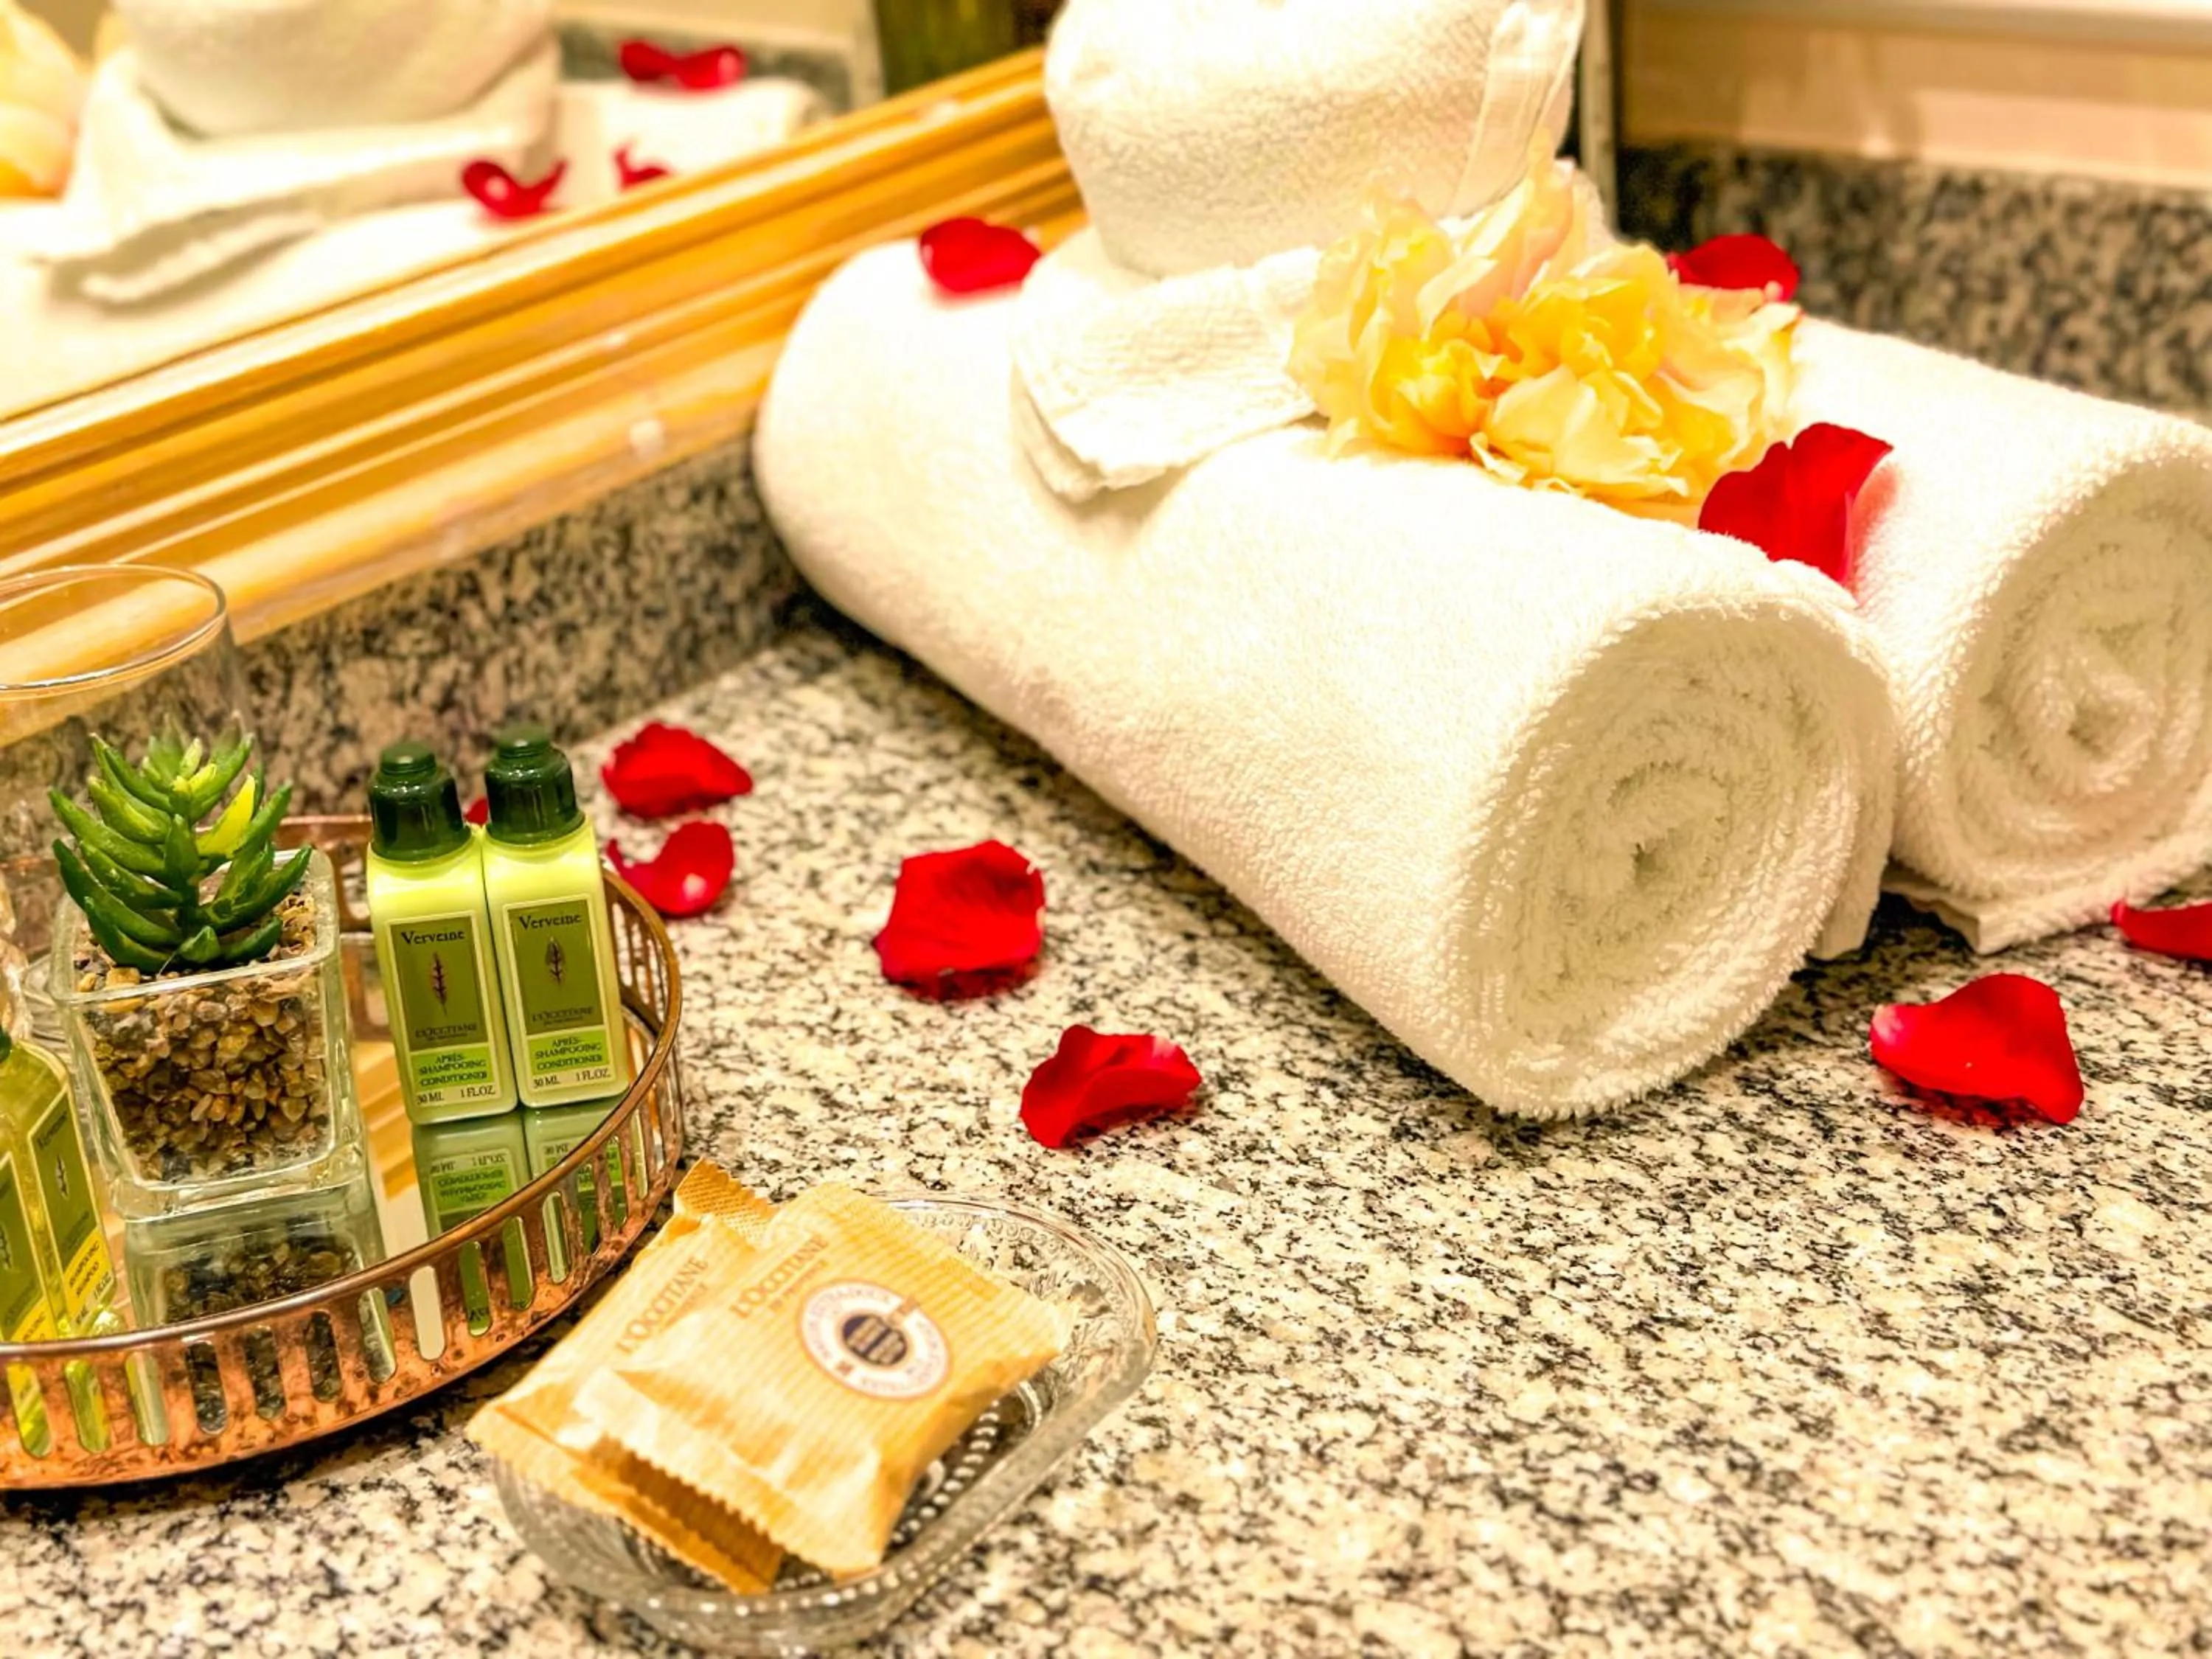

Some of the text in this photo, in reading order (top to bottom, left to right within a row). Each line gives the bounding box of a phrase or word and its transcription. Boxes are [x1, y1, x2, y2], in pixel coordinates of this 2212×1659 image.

[518, 914, 581, 931] Verveine
[400, 930, 465, 945] Verveine
[533, 1078, 543, 1089] 30
